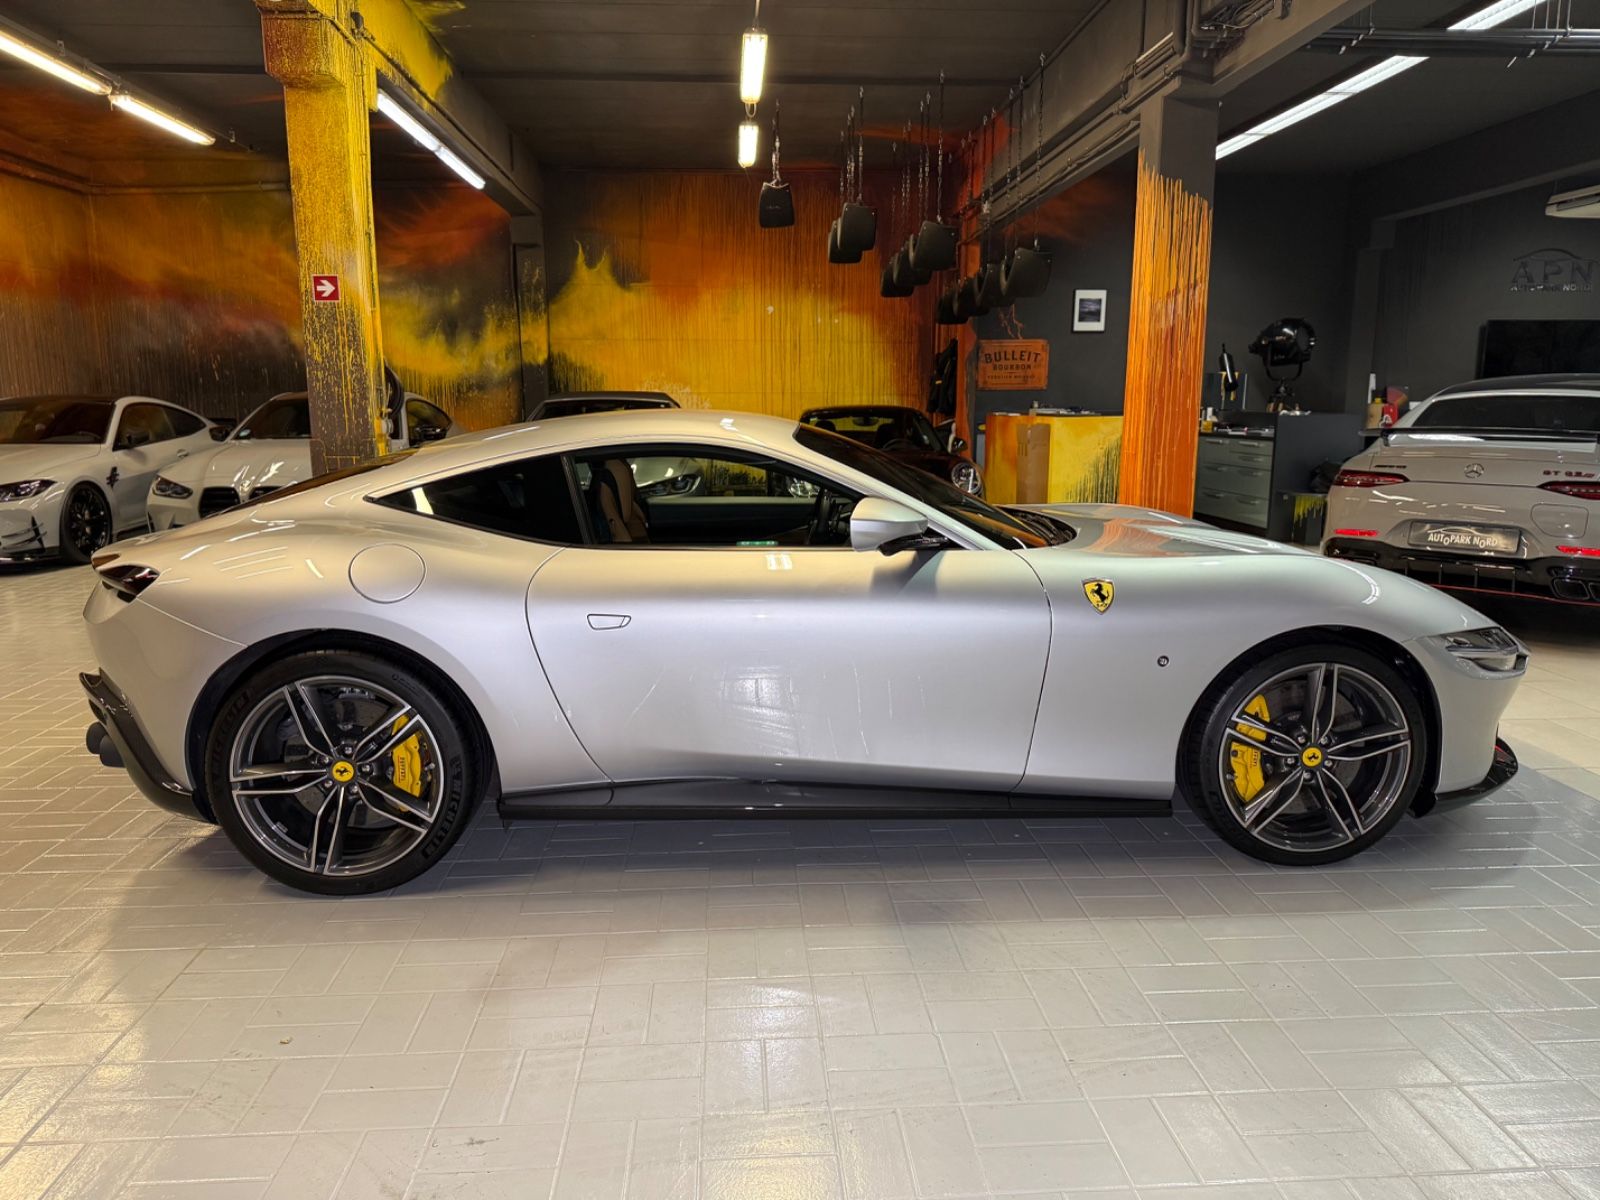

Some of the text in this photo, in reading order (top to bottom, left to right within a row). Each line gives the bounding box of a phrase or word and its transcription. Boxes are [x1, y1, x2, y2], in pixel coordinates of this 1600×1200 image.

[984, 350, 1041, 364] BULLEIT
[993, 363, 1032, 371] BOURBON
[1428, 533, 1498, 549] AUTOPARK NORD
